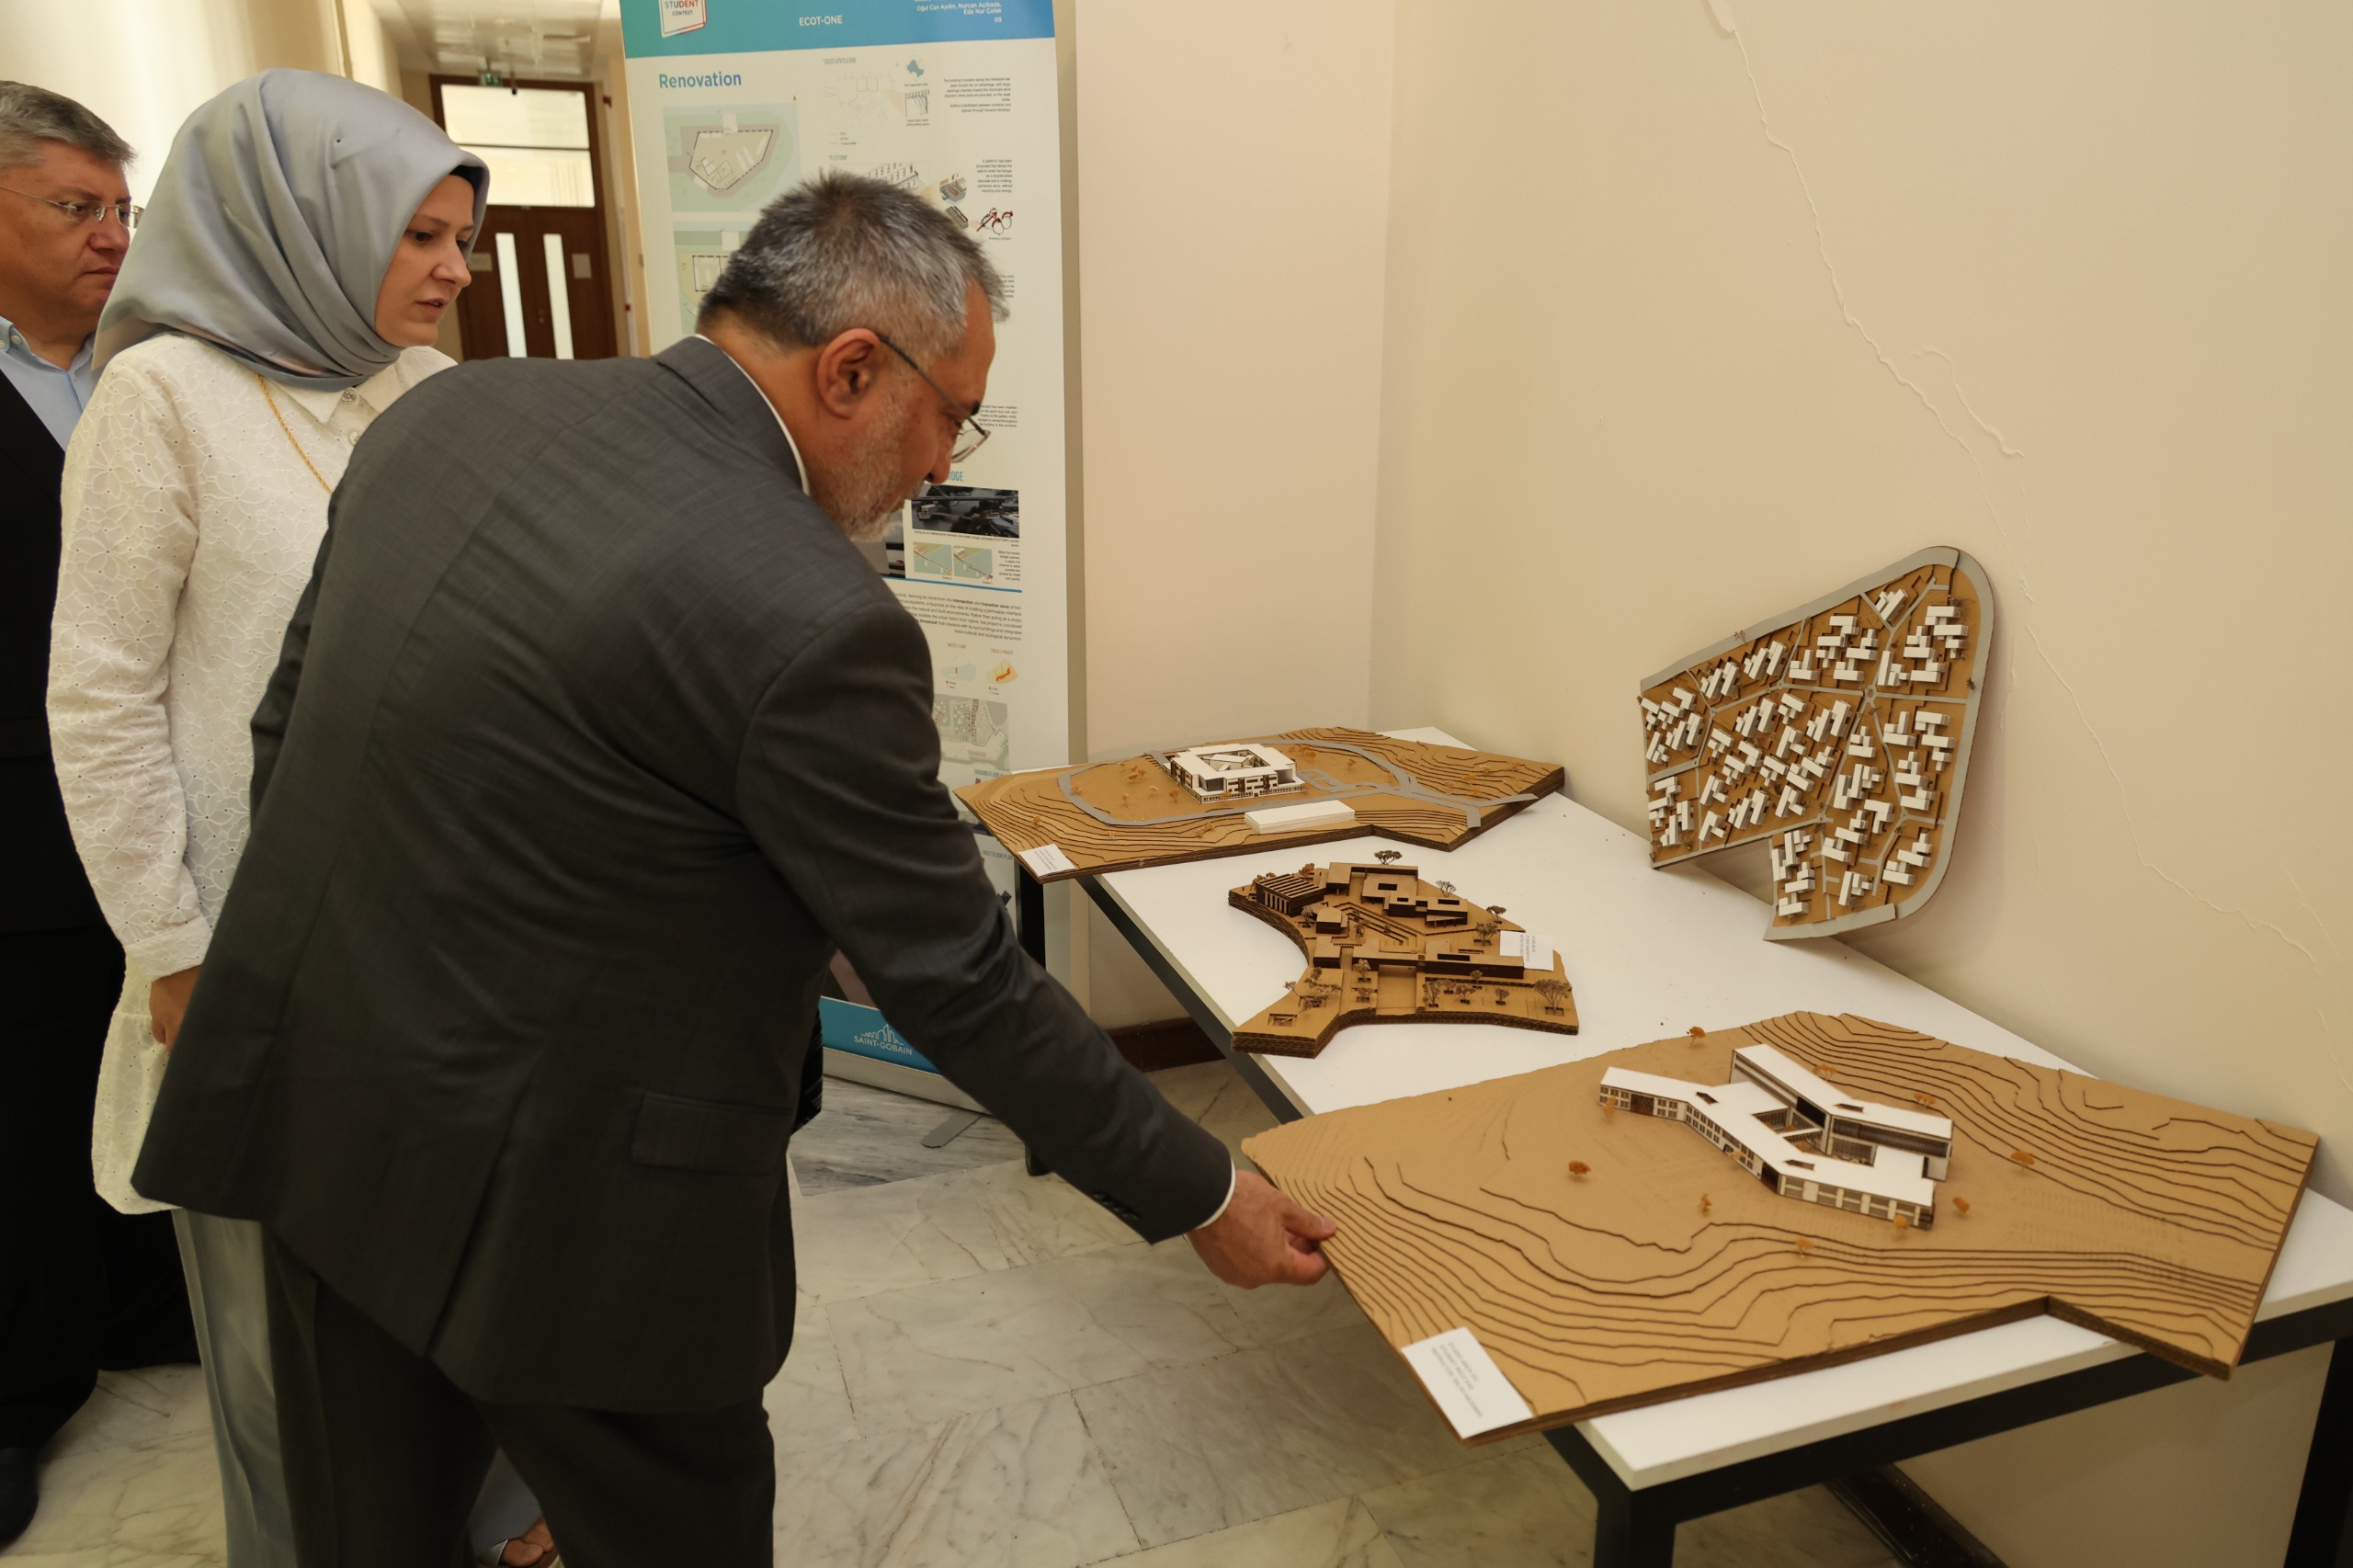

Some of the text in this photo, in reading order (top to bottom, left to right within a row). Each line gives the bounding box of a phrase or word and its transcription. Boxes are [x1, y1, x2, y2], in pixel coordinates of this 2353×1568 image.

[664, 0, 699, 9] STUDENT
[799, 15, 843, 27] ECOT-ONE
[659, 72, 742, 88] Renovation
[853, 1035, 913, 1055] SAINT-GOBAIN
